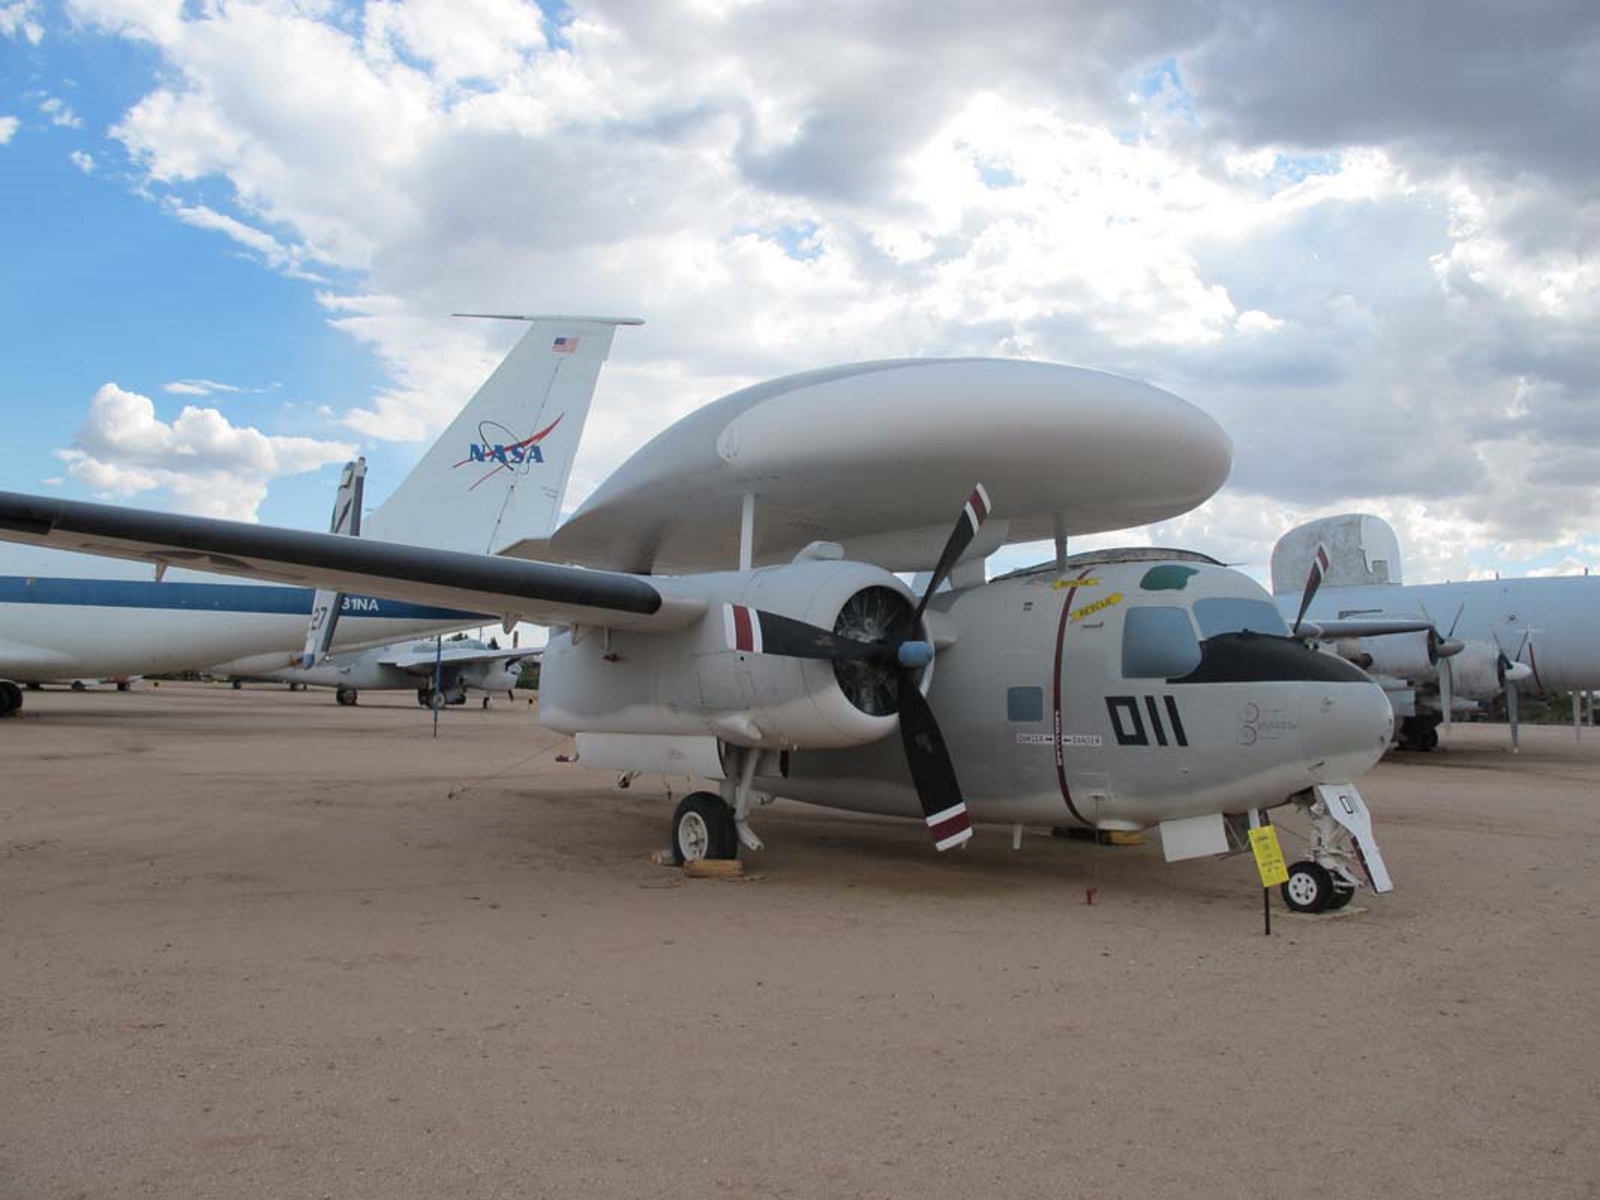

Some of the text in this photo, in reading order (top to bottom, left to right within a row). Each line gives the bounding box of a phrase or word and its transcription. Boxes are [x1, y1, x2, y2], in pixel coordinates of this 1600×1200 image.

[470, 443, 544, 463] NASA
[311, 607, 328, 630] 27
[1104, 695, 1188, 746] 011
